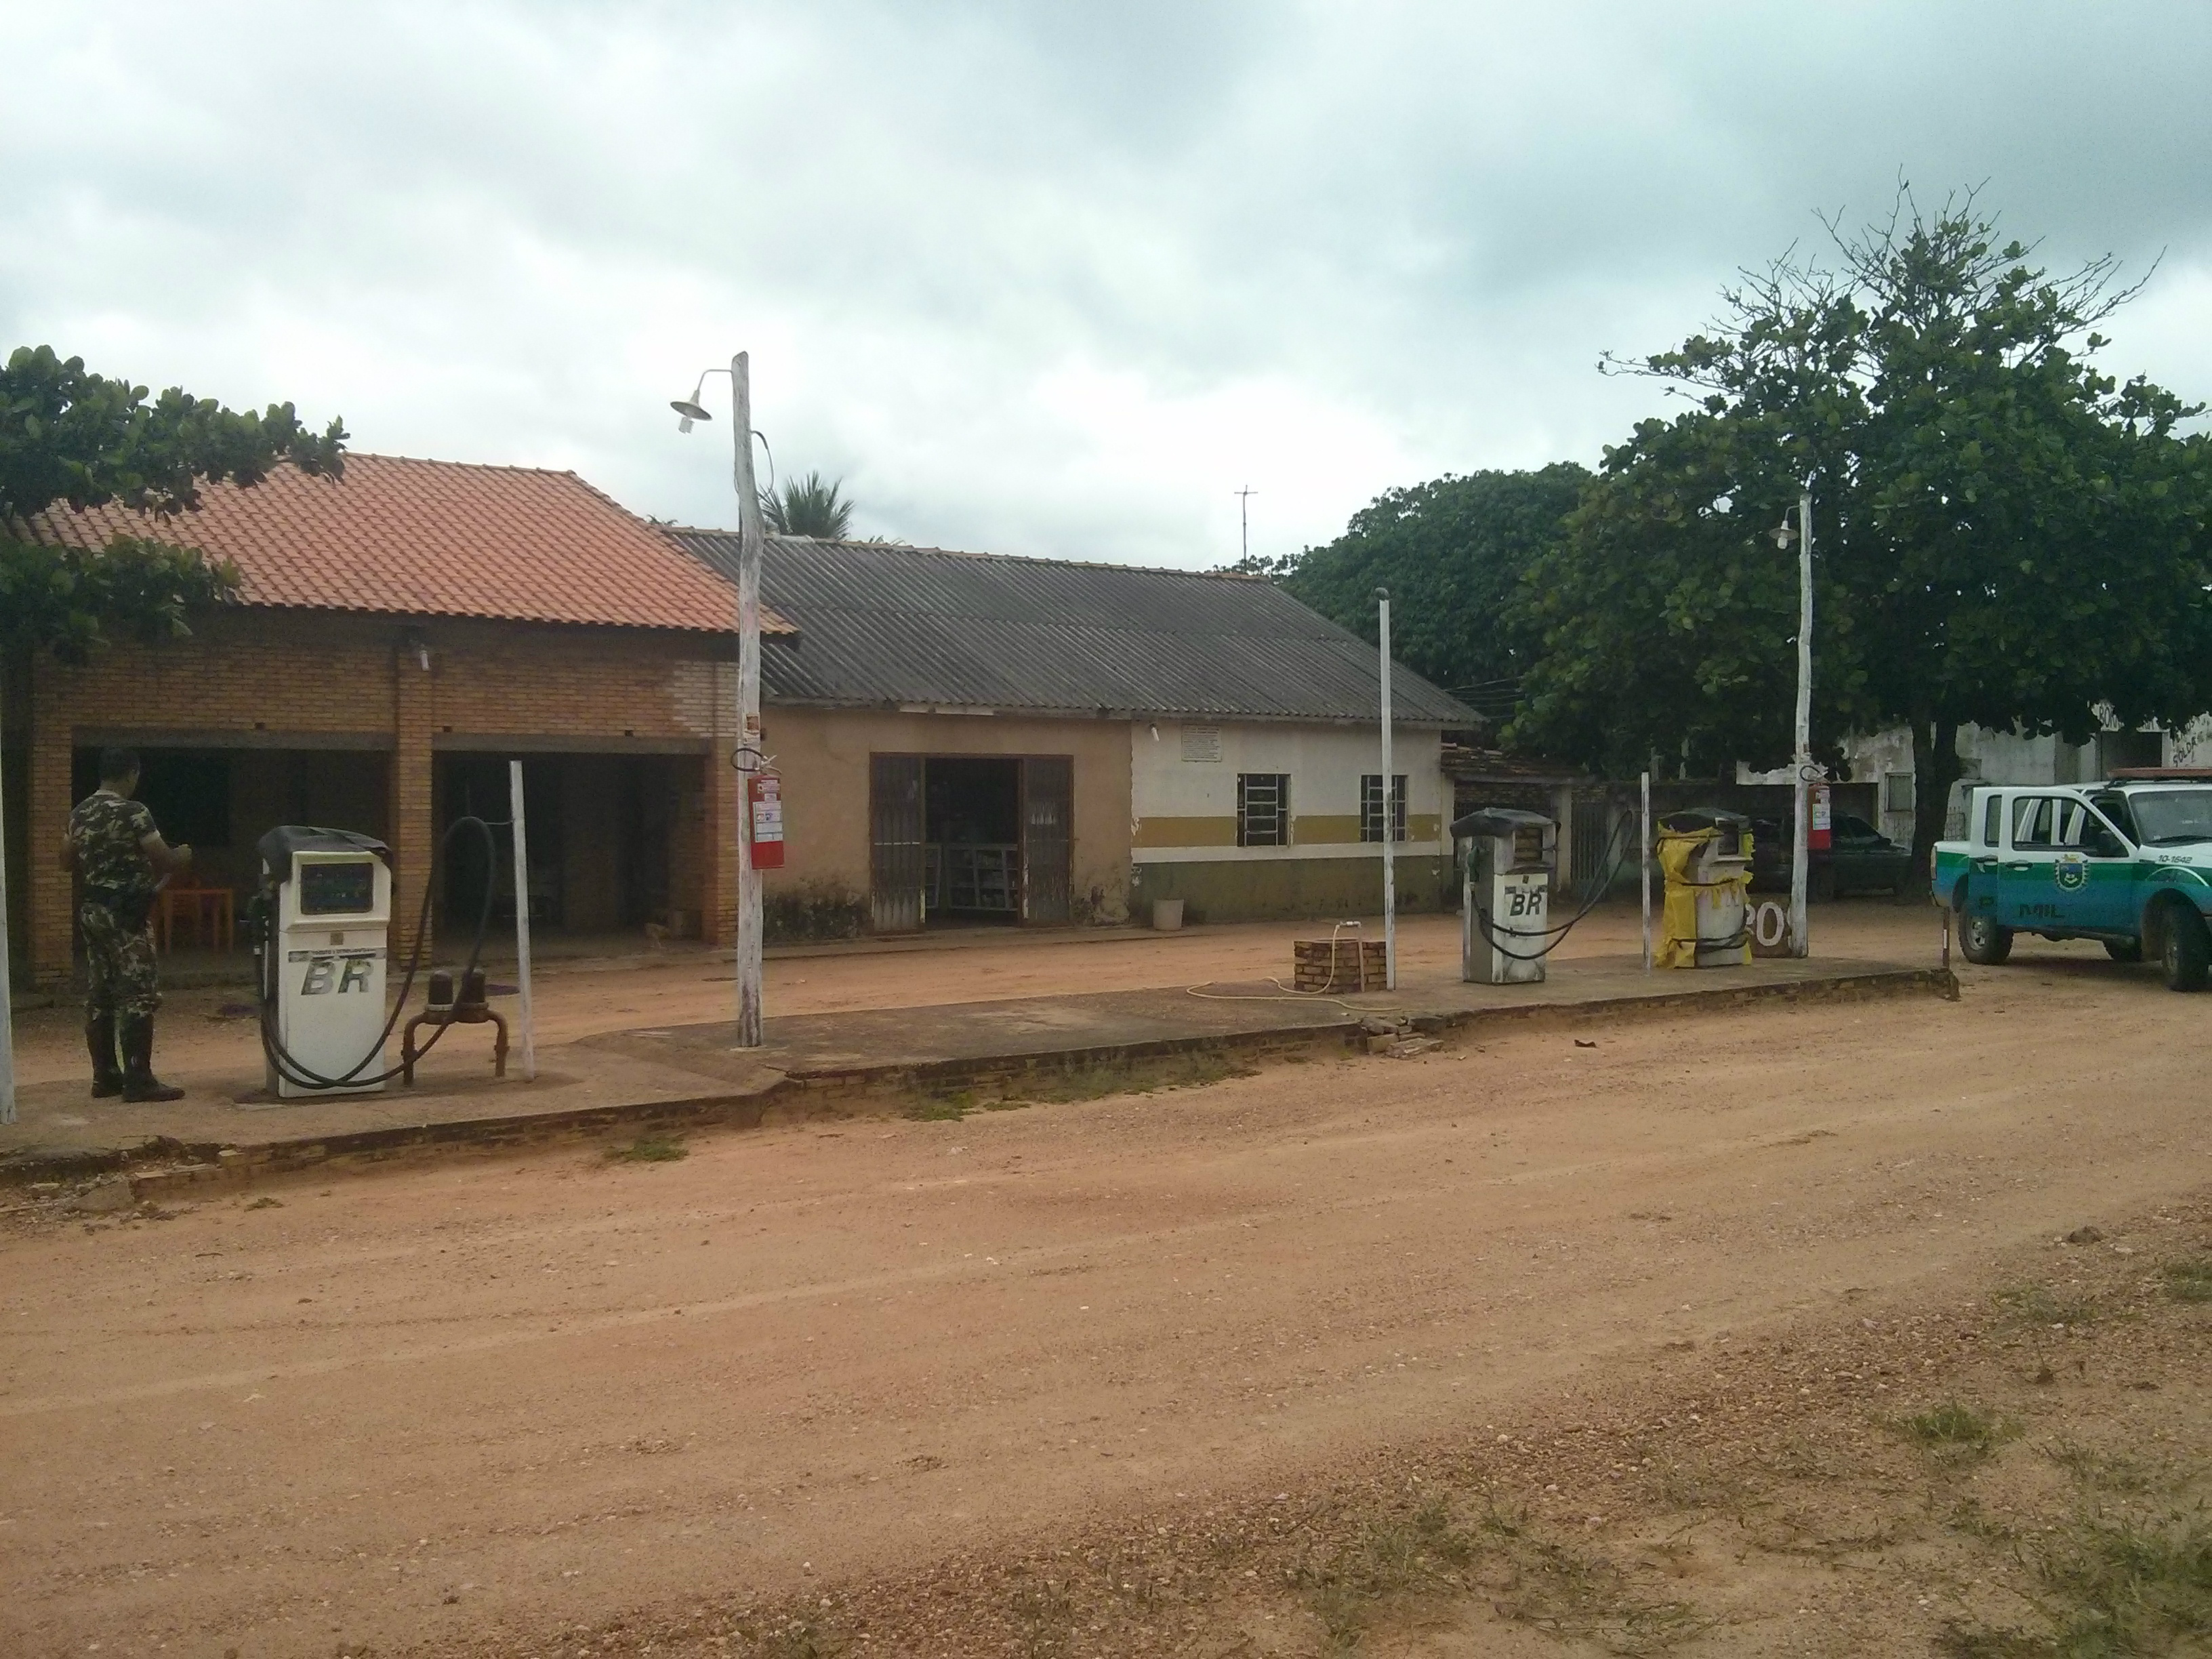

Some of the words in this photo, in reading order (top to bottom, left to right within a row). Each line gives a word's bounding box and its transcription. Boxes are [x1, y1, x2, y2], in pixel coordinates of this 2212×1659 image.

[2158, 855, 2193, 864] 10-1642
[1510, 890, 1542, 916] BR
[301, 960, 374, 996] BR
